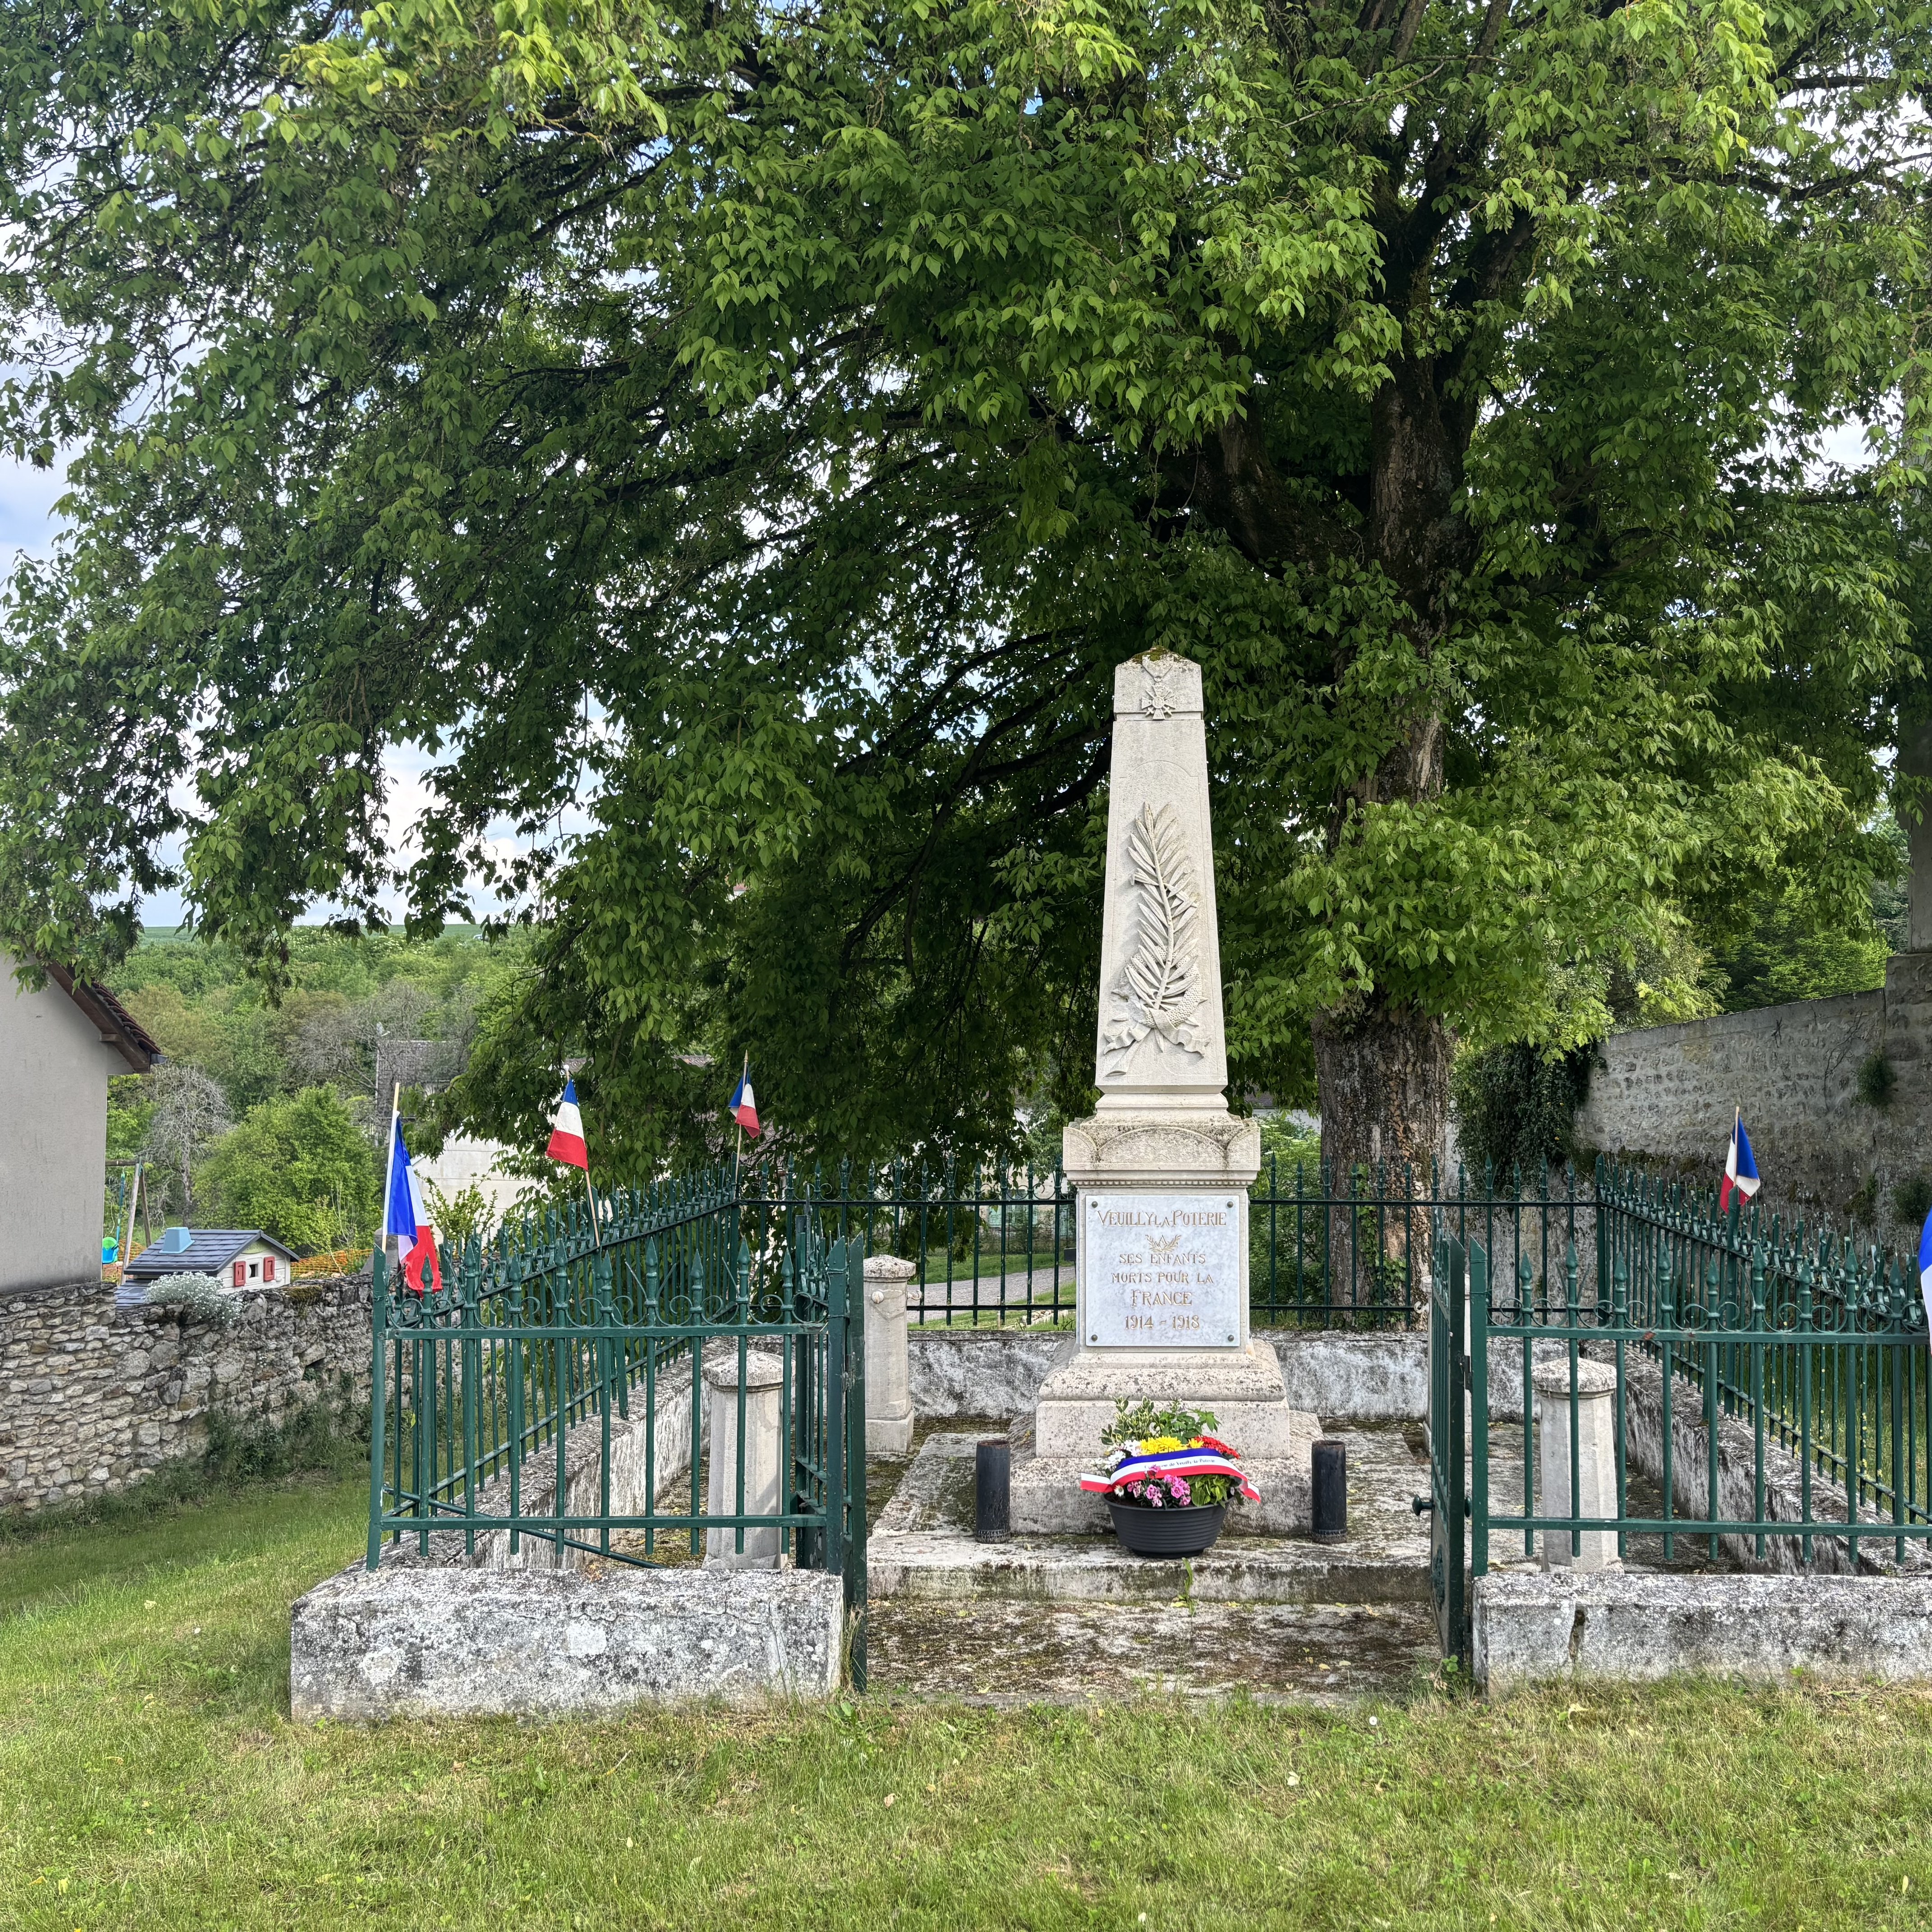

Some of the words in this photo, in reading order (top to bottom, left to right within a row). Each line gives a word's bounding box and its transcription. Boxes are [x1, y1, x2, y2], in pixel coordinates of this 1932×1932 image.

[1119, 1253, 1142, 1264] SES
[1150, 1251, 1206, 1265] ENFANTS
[1112, 1272, 1152, 1284] MORTS
[1158, 1270, 1188, 1284] POUR
[1197, 1272, 1214, 1284] LA
[1130, 1289, 1192, 1307] FRANCE
[1125, 1315, 1154, 1330] 1914
[1172, 1315, 1200, 1330] 1918
